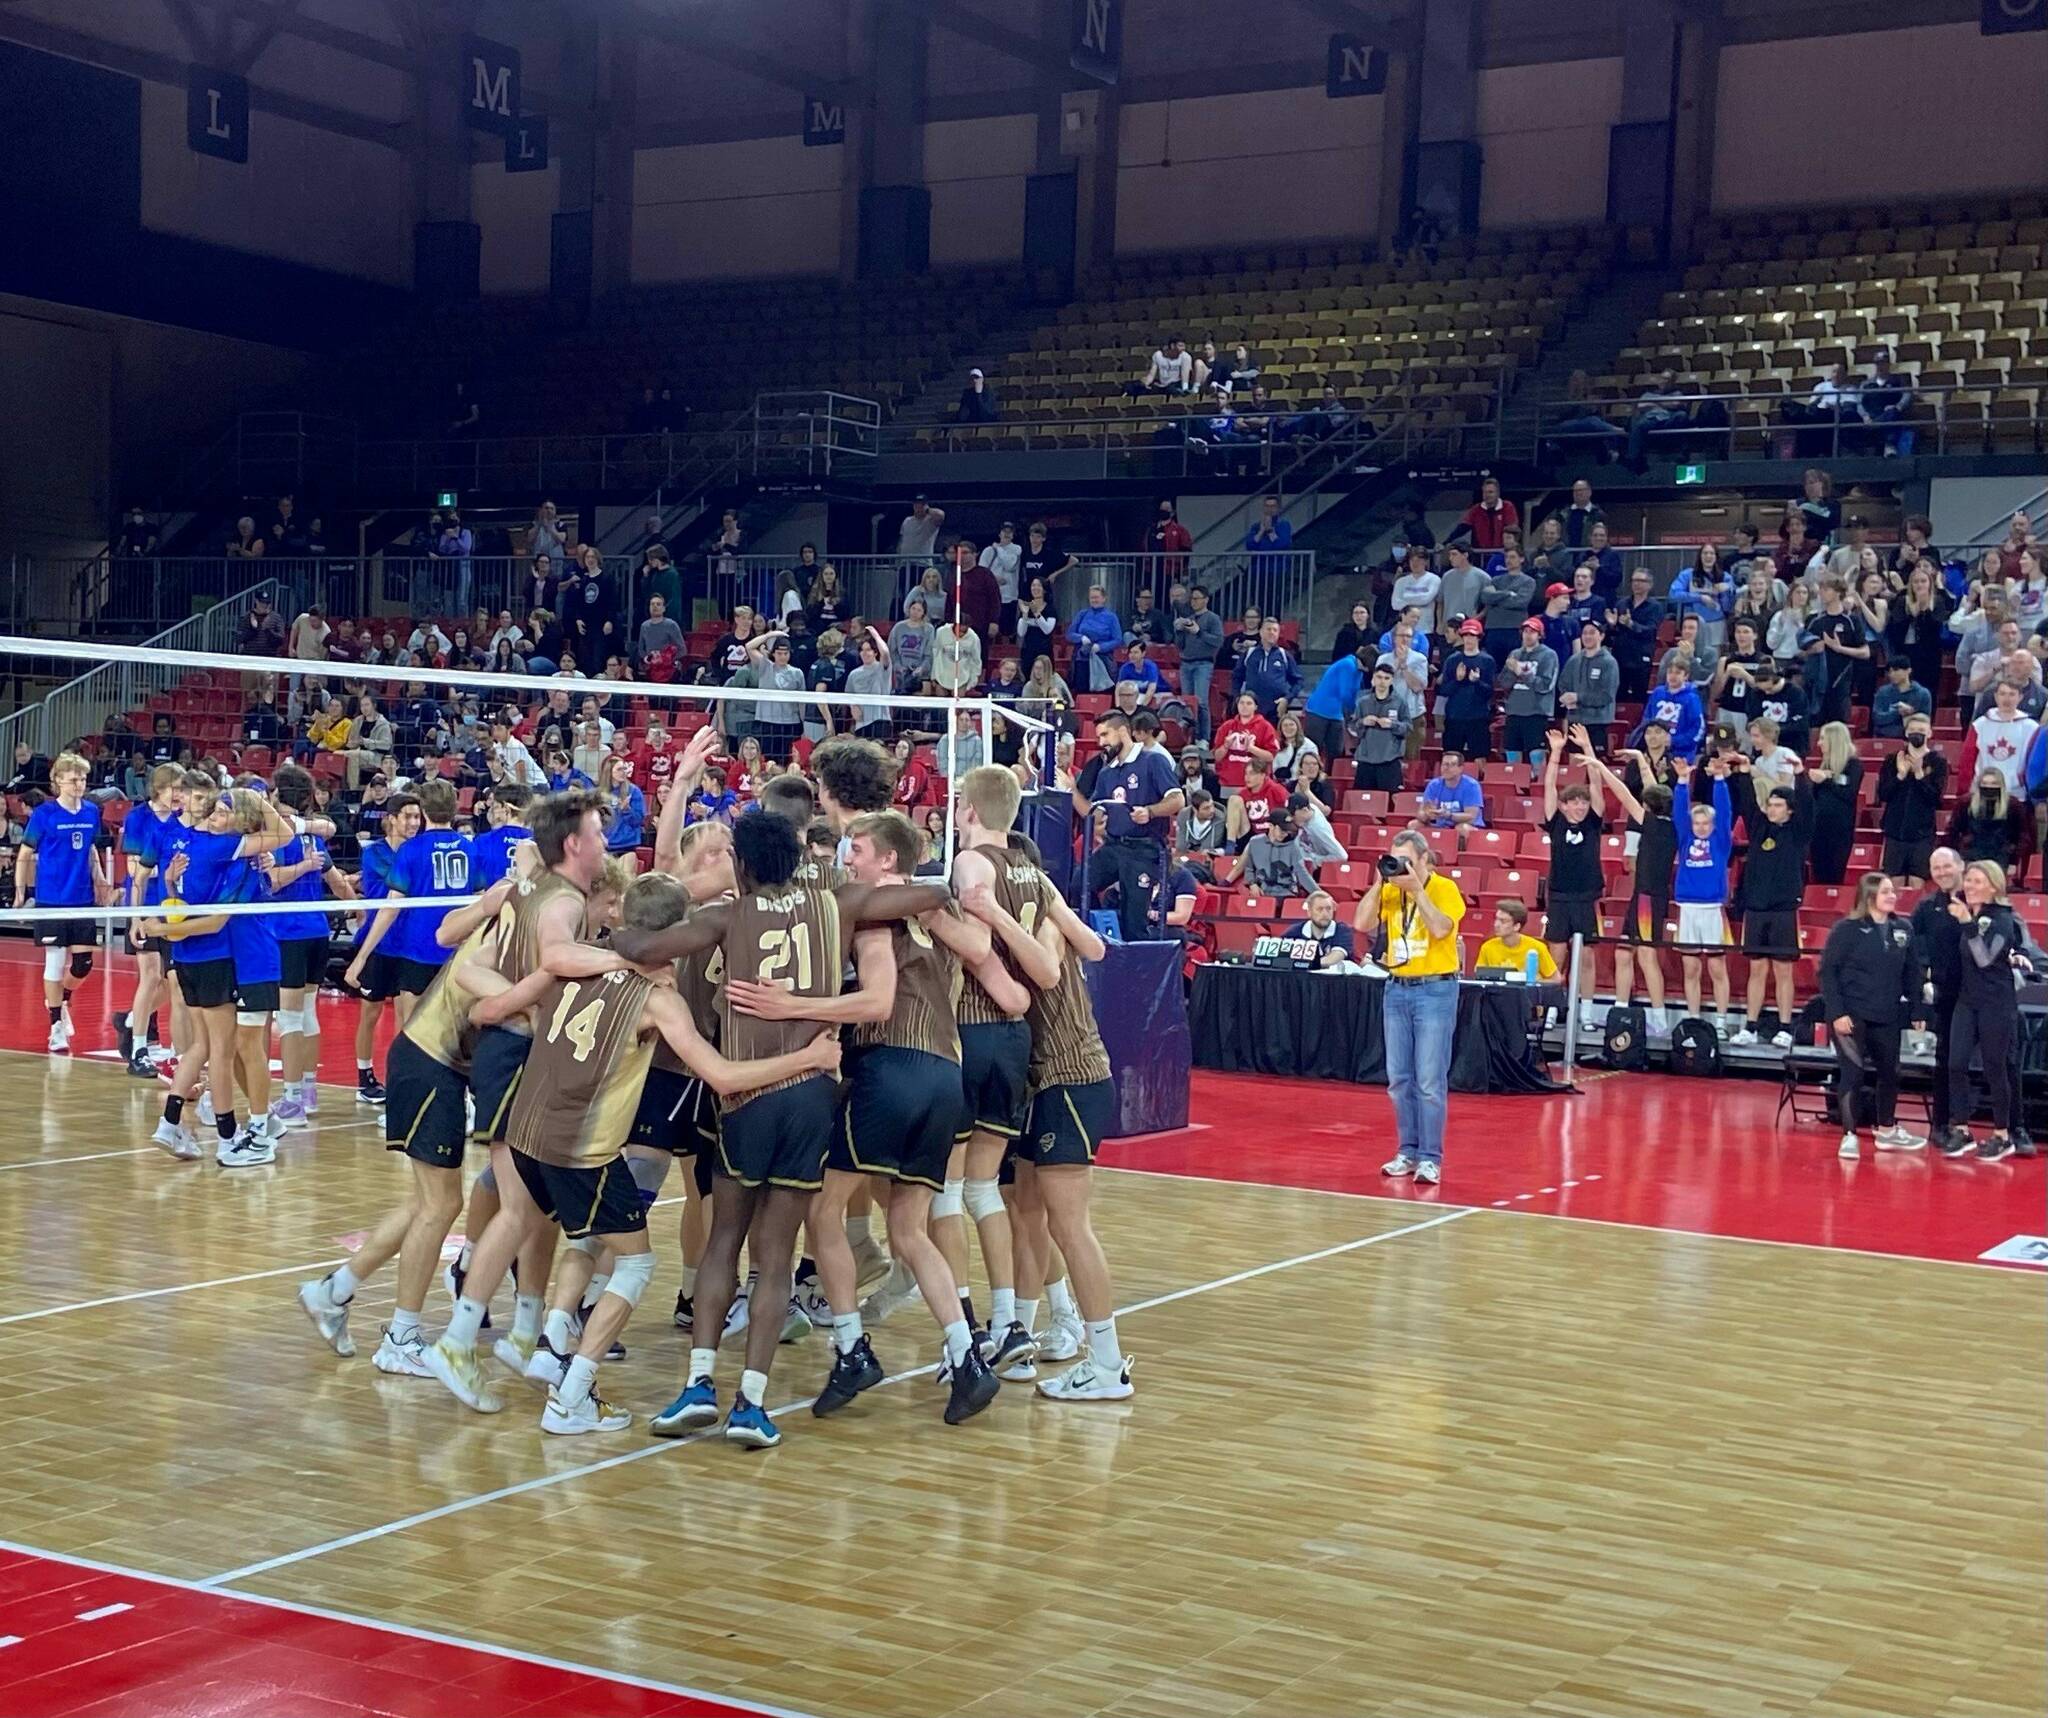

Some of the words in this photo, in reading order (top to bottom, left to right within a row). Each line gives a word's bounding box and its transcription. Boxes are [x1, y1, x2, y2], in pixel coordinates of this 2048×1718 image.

[1082, 0, 1110, 53] N
[1340, 45, 1374, 82] N
[472, 57, 511, 116] M
[207, 88, 230, 139] L
[811, 101, 844, 132] M
[519, 130, 535, 158] L
[431, 850, 469, 890] 10
[759, 921, 812, 990] 21
[1256, 940, 1279, 957] 12
[1292, 943, 1317, 958] 25
[547, 981, 605, 1063] 14
